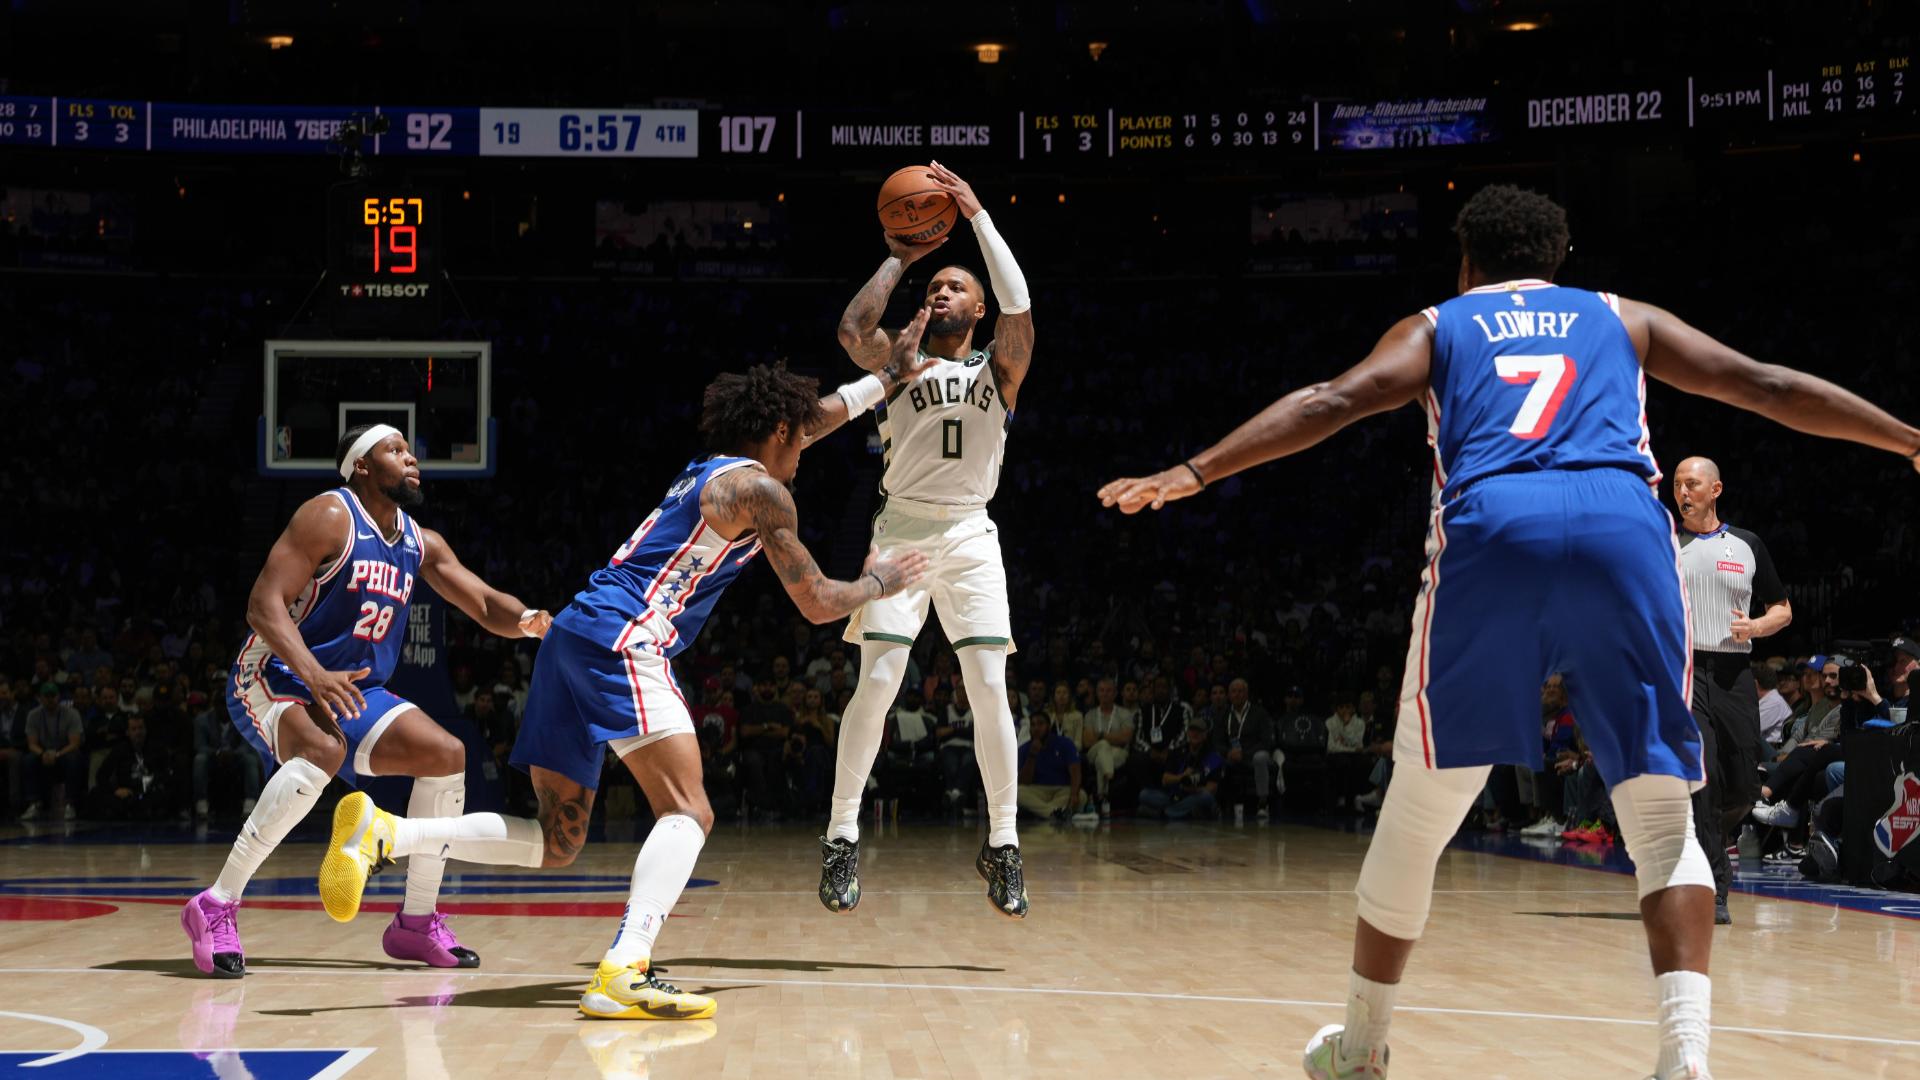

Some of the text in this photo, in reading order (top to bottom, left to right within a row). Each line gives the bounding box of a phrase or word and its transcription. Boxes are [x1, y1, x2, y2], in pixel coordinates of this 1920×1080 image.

[1855, 61, 1876, 74] AST
[1889, 56, 1910, 70] BLK
[1783, 71, 1904, 100] PHI 40 16 2
[28, 103, 38, 118] 7
[69, 102, 136, 120] FLS TOL
[1528, 89, 1662, 128] DECEMBER 22
[1783, 89, 1903, 118] MIL 41 24 7
[25, 123, 42, 138] 13
[74, 121, 129, 143] 3 3
[173, 116, 287, 141] PHILADELPHIA
[406, 112, 453, 151] 92
[494, 114, 686, 151] 19 6:57 4TH
[1035, 114, 1099, 130] FLS TOL
[1120, 110, 1307, 131] PLAYER 11 5 0 9 24
[719, 115, 777, 154] 107
[831, 124, 990, 147] MILWAUKEE BUCKS
[1042, 130, 1093, 153] 1 3
[1120, 129, 1302, 150] POINTS 6 9 30 13 9
[364, 198, 422, 225] 6:57
[374, 225, 417, 274] 19
[364, 284, 429, 297] TISSOT
[1472, 310, 1580, 342] LOWRY
[909, 377, 994, 413] BUCKS
[1494, 354, 1577, 440] 7
[942, 419, 963, 460] 0
[347, 559, 414, 606] PHILA
[352, 600, 394, 644] 28
[410, 603, 431, 623] GET
[409, 624, 431, 645] THE
[413, 647, 436, 668] App
